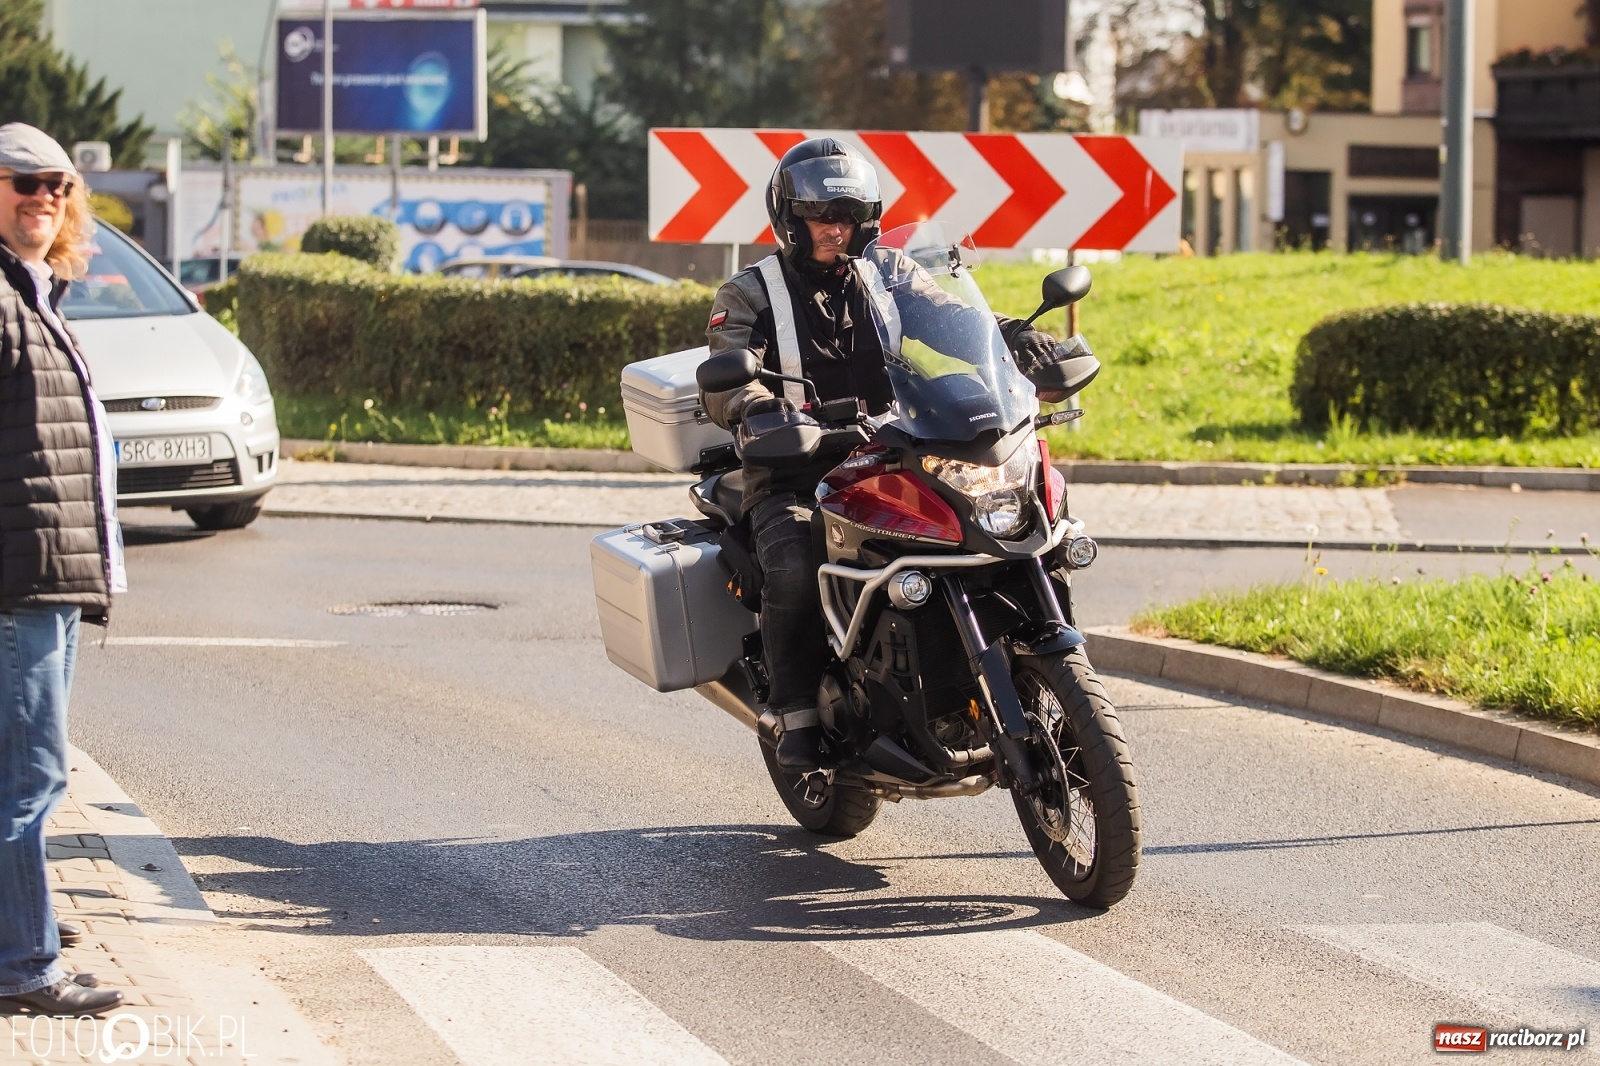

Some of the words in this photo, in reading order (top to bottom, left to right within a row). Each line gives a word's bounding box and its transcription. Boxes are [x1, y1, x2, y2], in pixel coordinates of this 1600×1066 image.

[969, 412, 998, 422] HONDA
[122, 441, 156, 462] SRC
[163, 439, 206, 460] 8XH3
[849, 521, 917, 540] CROSSTOURER
